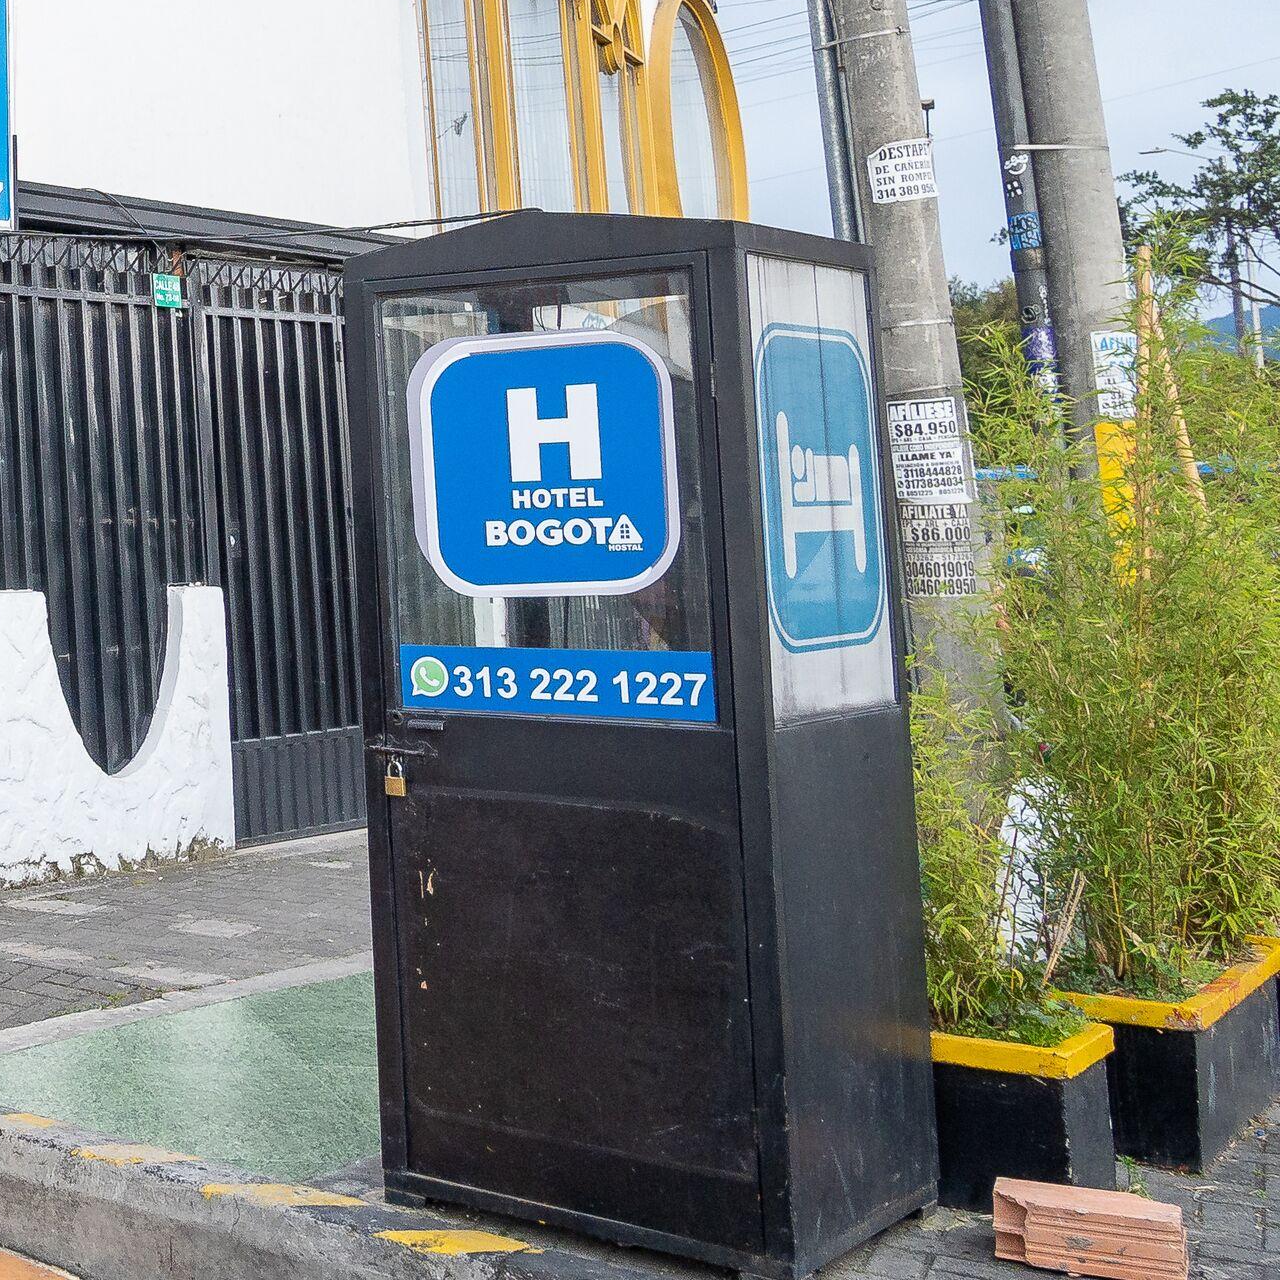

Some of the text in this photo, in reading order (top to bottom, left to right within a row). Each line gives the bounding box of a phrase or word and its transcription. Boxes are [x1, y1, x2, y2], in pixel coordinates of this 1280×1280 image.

[875, 165, 890, 175] DE
[876, 176, 895, 187] SIN
[877, 188, 896, 200] 314
[899, 185, 919, 197] 389
[506, 383, 603, 483] H
[894, 420, 956, 438] $84.950
[903, 465, 962, 478] 3118444828
[905, 476, 963, 489] 3173834034
[512, 487, 604, 509] HOTEL
[902, 503, 967, 519] AFILIATE YA
[485, 513, 643, 547] BOGOTA
[911, 527, 971, 542] $86.000
[608, 544, 644, 552] HOSTAL
[906, 561, 975, 578] 3046019019
[452, 666, 707, 707] 313 222 1227
